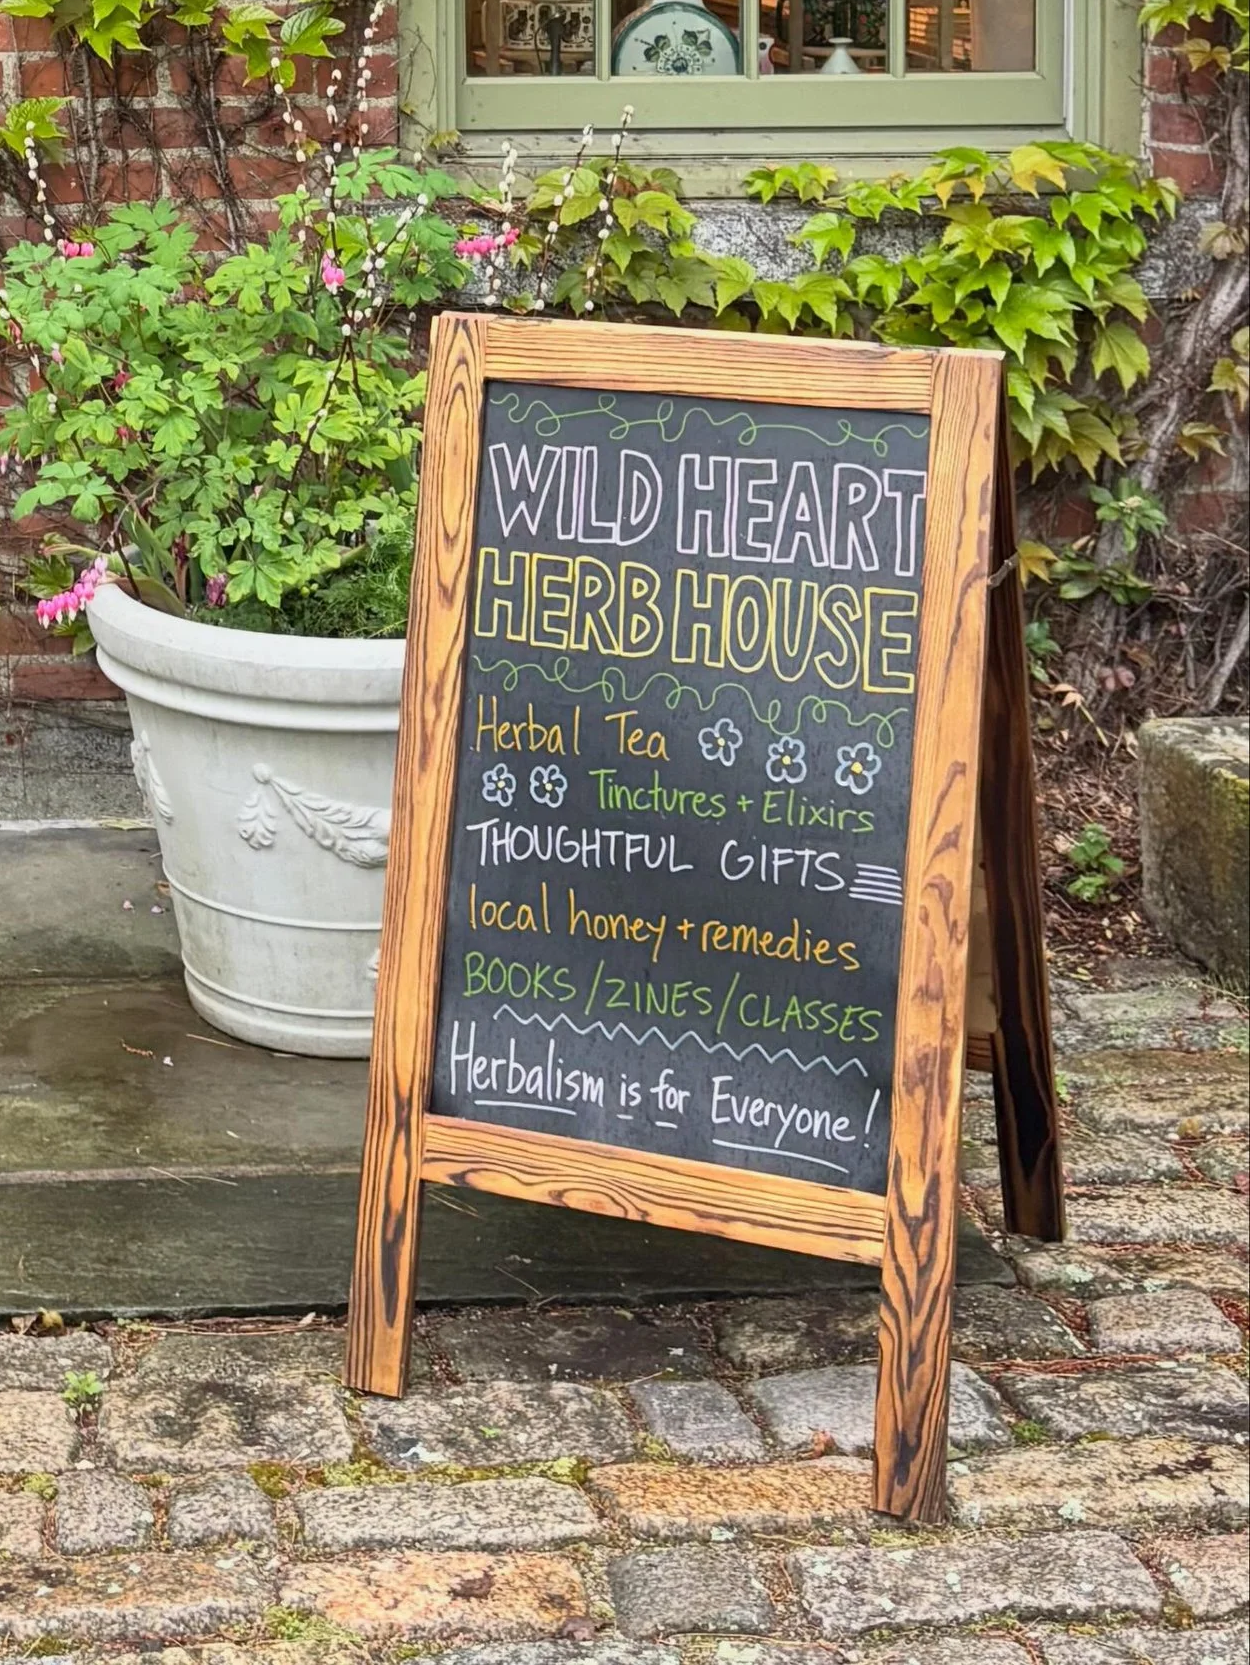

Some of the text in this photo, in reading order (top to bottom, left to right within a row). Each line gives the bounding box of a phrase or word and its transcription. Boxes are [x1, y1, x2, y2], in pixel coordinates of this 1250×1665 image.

[488, 442, 927, 576] WILD HEART
[475, 547, 918, 694] HERB HOUSE
[476, 694, 670, 761] Herbal Tea
[588, 769, 726, 817] Tinctures
[762, 789, 875, 833] Elixirs
[466, 818, 845, 891] THOUGHTFUL GIFTS
[469, 882, 552, 934] local
[569, 888, 667, 963] honey
[701, 918, 861, 971] remedies
[450, 1020, 604, 1108] Herbalism
[620, 1073, 642, 1107] is
[650, 1068, 691, 1114] for
